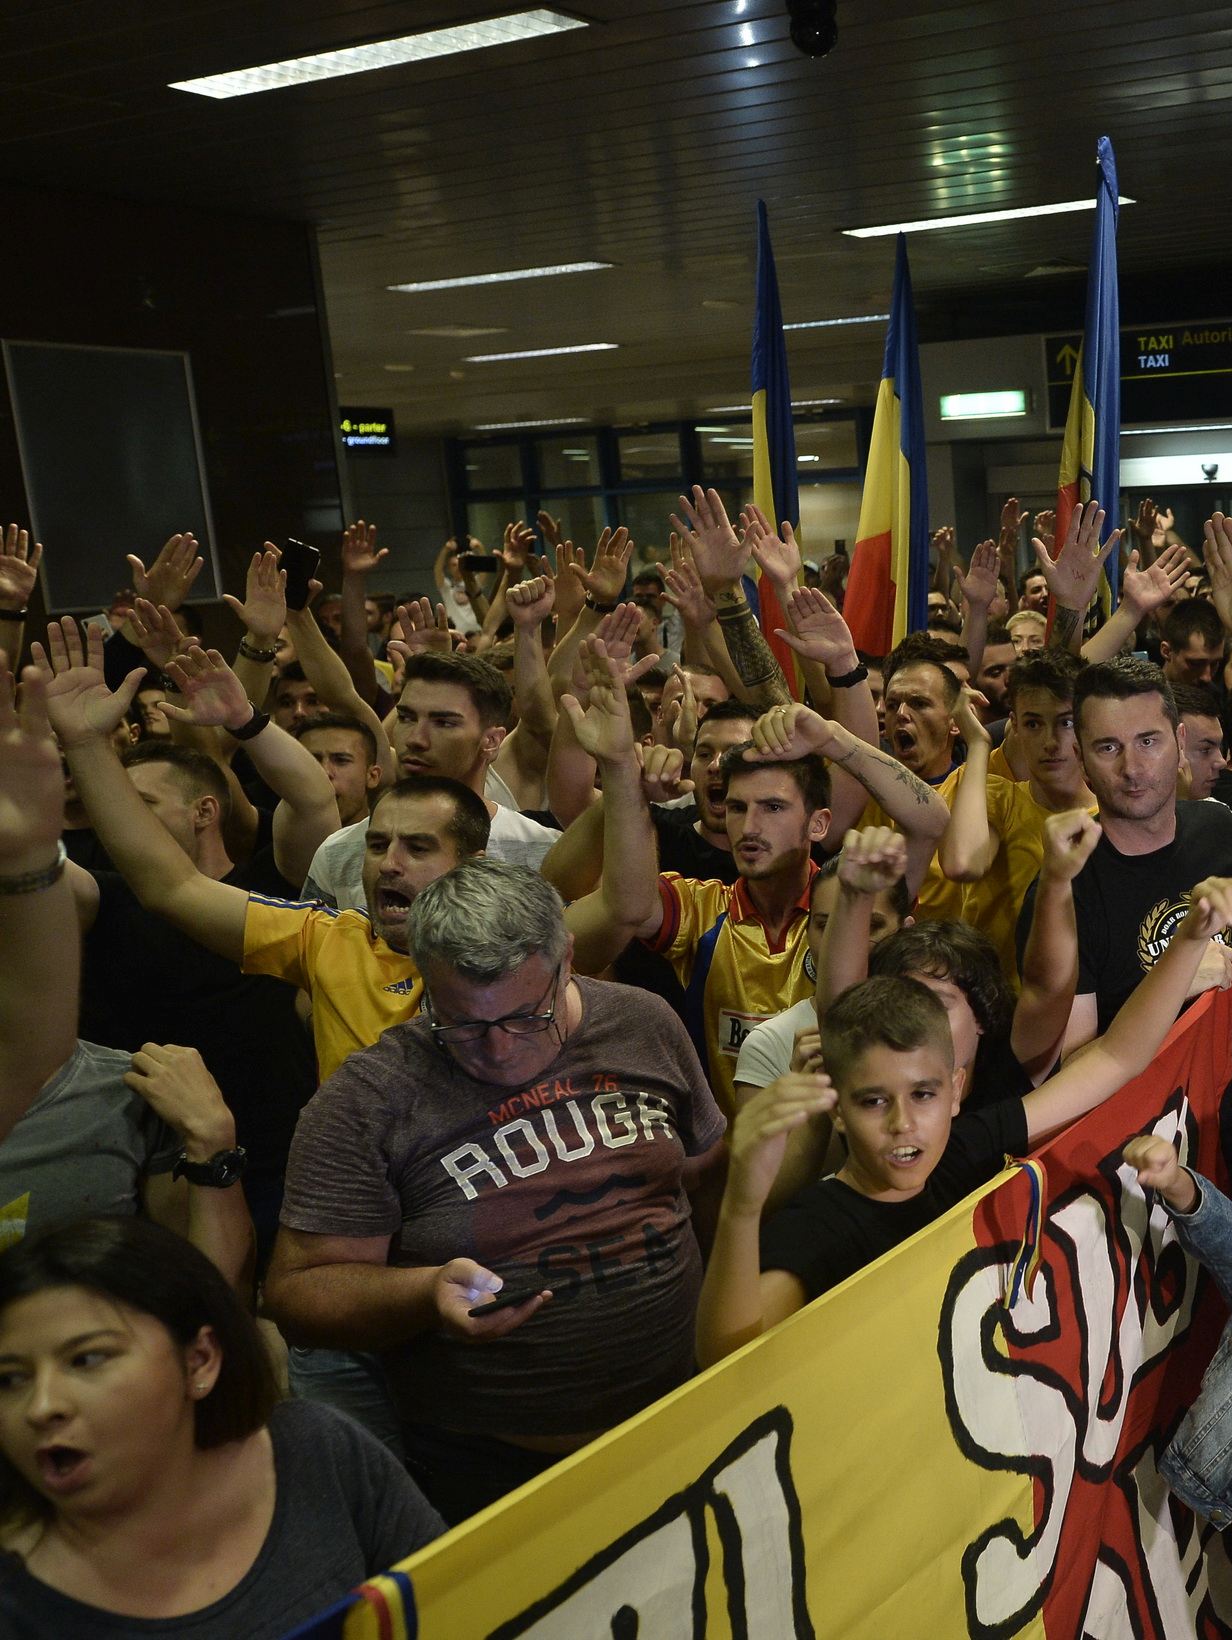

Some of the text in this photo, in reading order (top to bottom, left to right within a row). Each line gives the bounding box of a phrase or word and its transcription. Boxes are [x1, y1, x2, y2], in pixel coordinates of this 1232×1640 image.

[1138, 336, 1174, 351] TAXI
[1138, 354, 1170, 369] TAXI
[487, 1077, 581, 1126] MCNEAL
